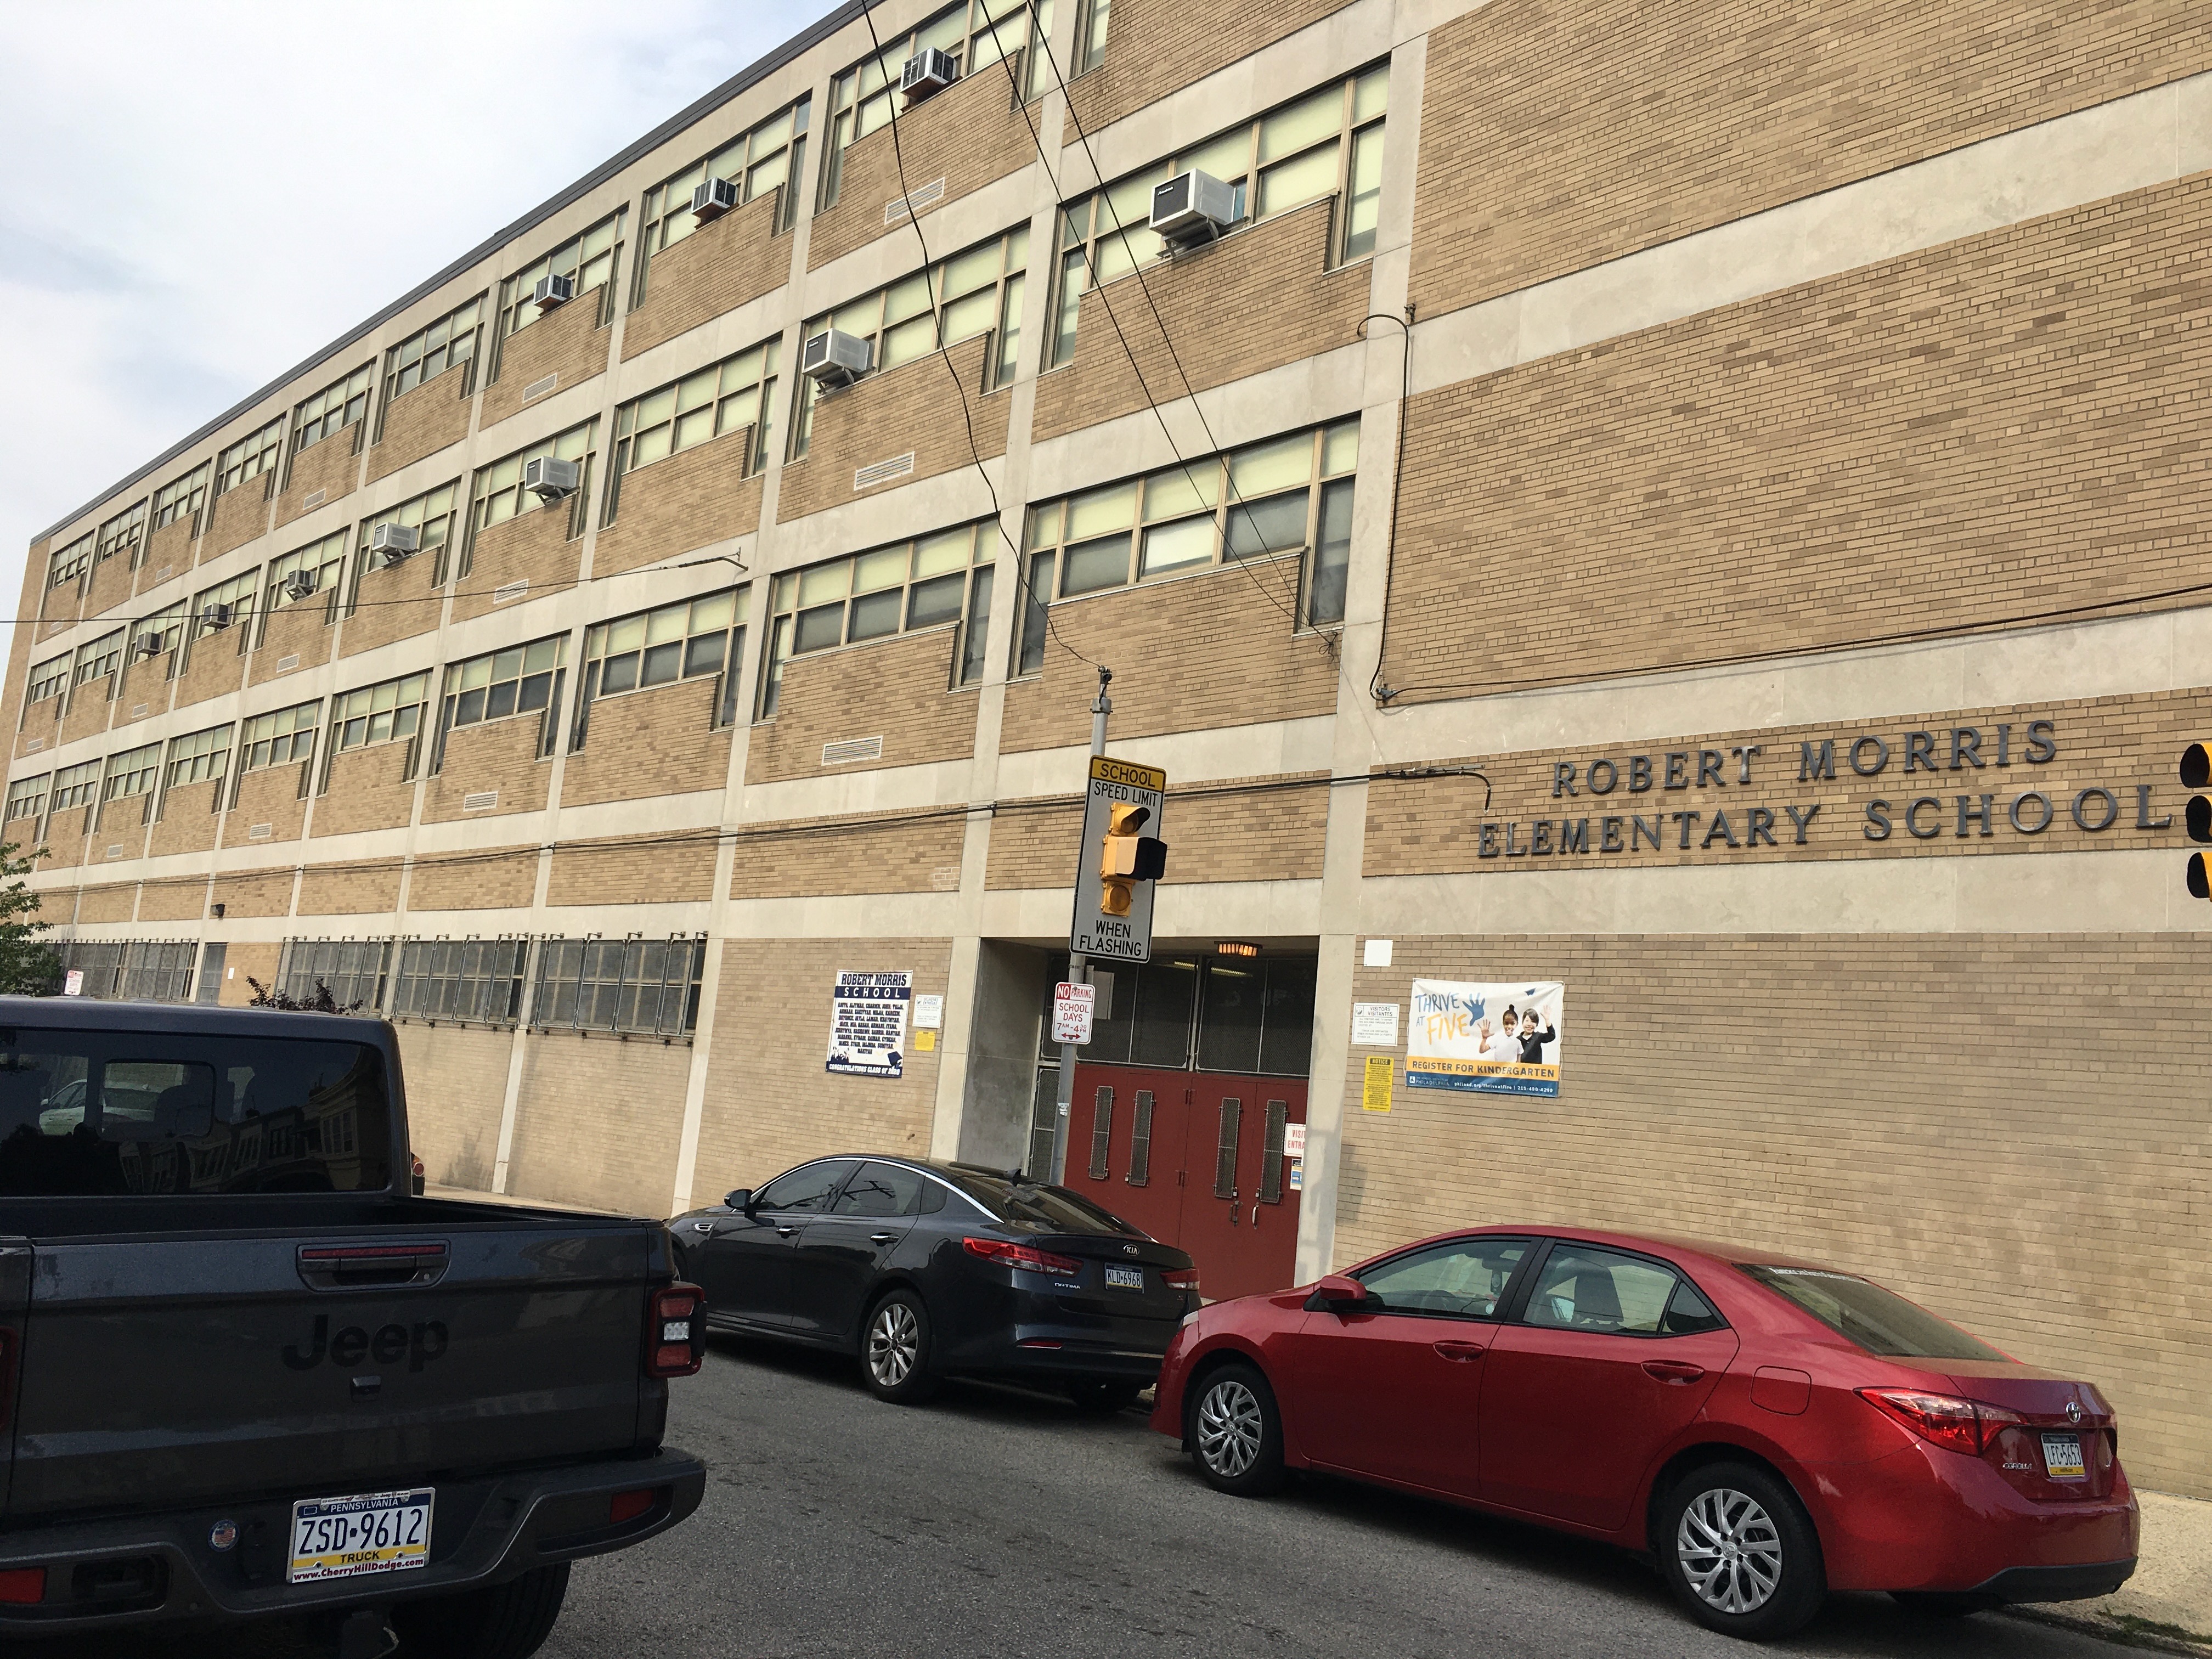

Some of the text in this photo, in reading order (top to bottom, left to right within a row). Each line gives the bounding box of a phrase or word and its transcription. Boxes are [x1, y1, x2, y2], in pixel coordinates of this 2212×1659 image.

[1551, 719, 2057, 797] ROBERT MORRIS
[1099, 763, 1156, 788] SCHOOL
[1094, 782, 1158, 807] SPEED LIMIT
[1476, 785, 2173, 859] ELEMENTARY SCHOOL
[1095, 920, 1131, 939] WHEN
[1079, 935, 1142, 957] FLASHING
[841, 973, 907, 986] ROBERT MORRIS
[844, 987, 900, 998] SCHOOL
[1057, 985, 1092, 998] NO PARKING
[1059, 1002, 1089, 1013] SCHOOL
[1414, 991, 1460, 1012] THRIVE
[1063, 1012, 1083, 1022] DAYS
[1416, 1013, 1470, 1045] AT FIVE
[829, 1064, 867, 1073] CONGRATULATIONS
[1412, 1060, 1554, 1077] REGISTER FOR KINDERGARTEN
[1292, 1130, 1306, 1138] VISIT
[1288, 1140, 1305, 1149] ENTRA
[1126, 1245, 1138, 1255] KIA
[281, 1313, 449, 1372] Jeep
[330, 1498, 399, 1513] PENNSYLVANIA
[340, 1550, 380, 1564] TRUCK
[294, 1558, 424, 1581] www.CherryHillDodge.com
